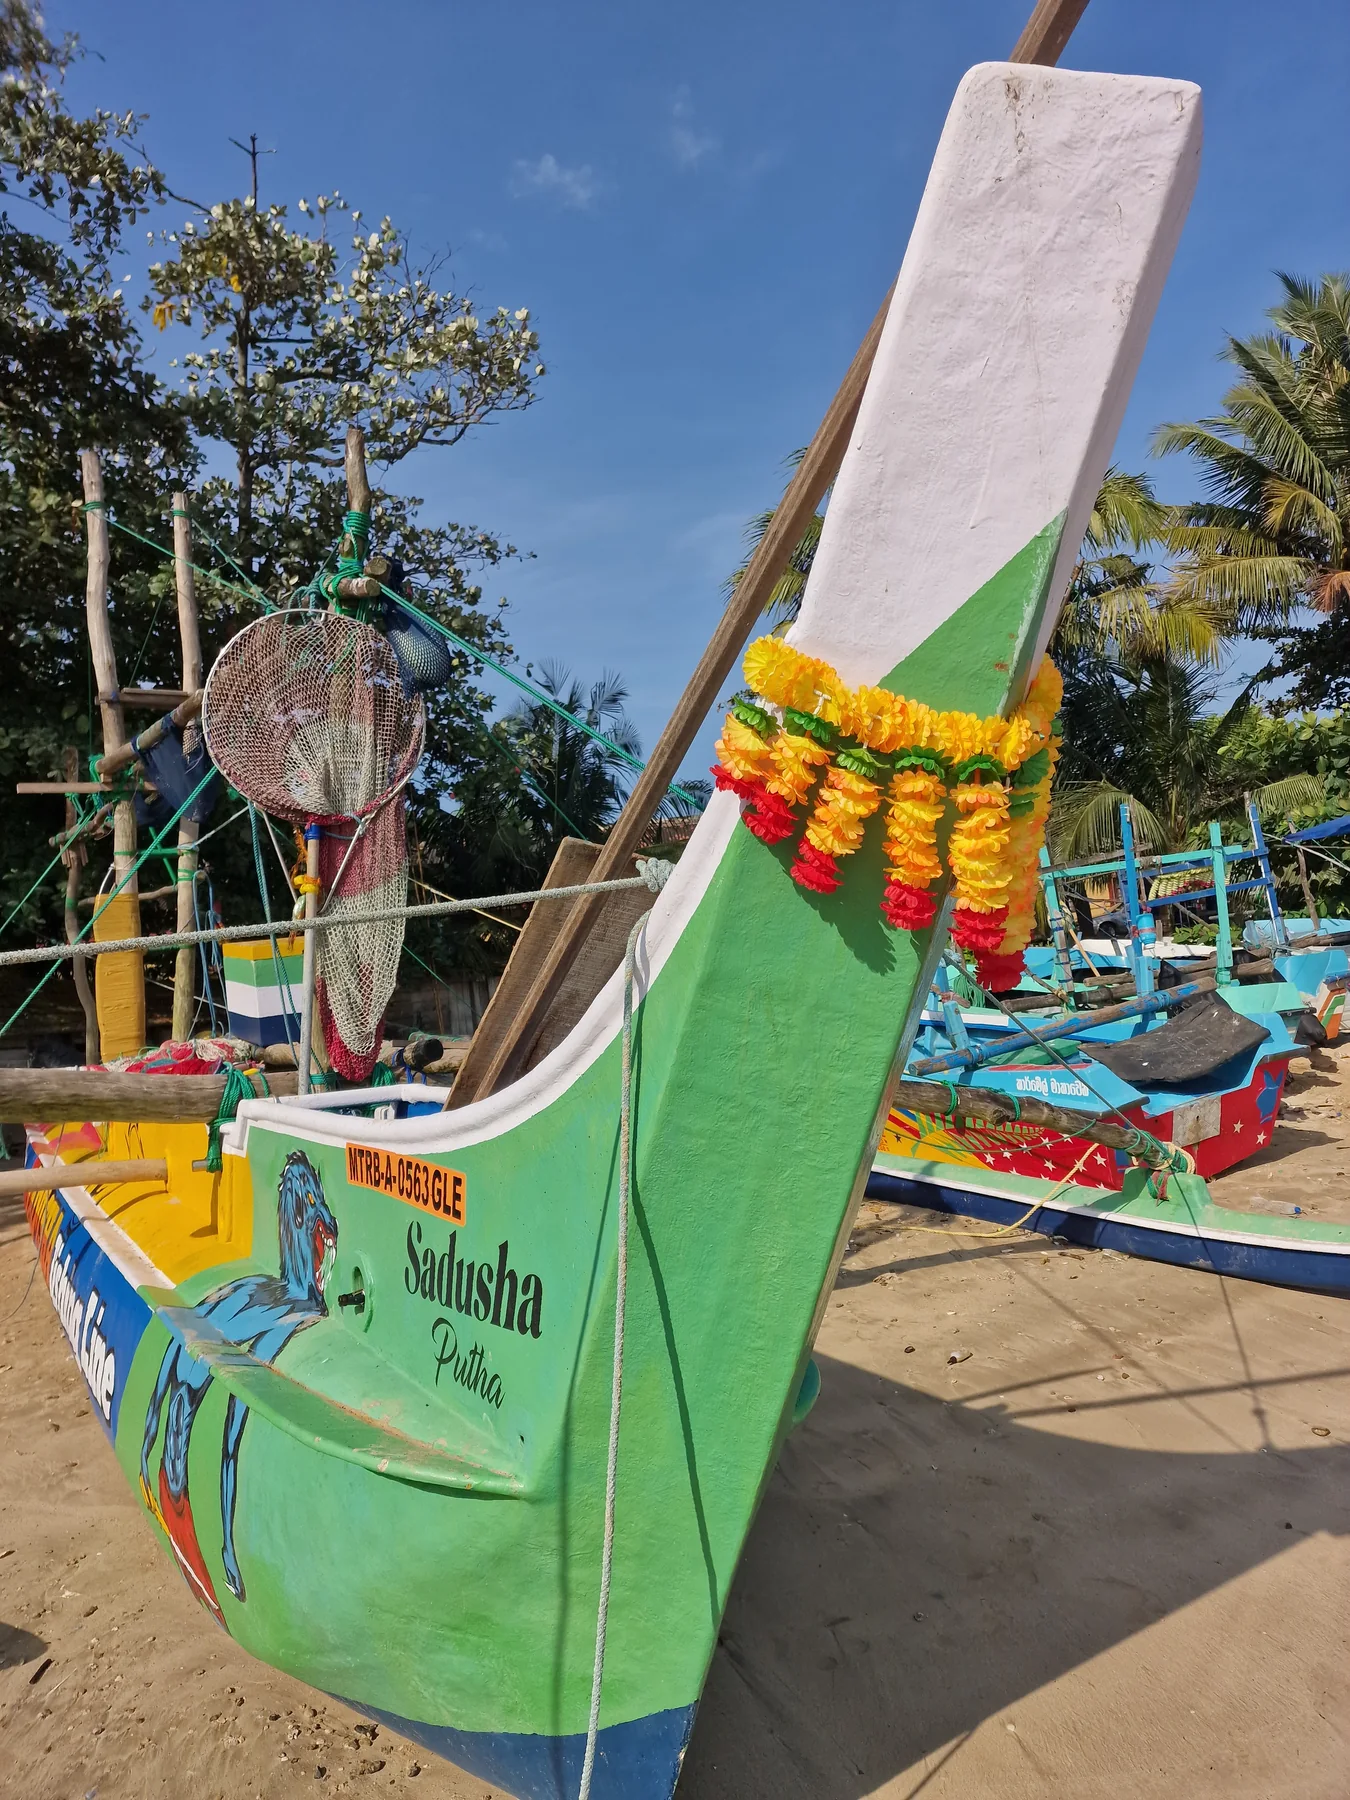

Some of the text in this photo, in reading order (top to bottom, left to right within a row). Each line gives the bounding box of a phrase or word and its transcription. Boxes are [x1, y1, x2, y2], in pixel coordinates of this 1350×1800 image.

[405, 1221, 543, 1339] Sadusha
[81, 1290, 115, 1420] Line
[431, 1317, 506, 1410] Putha
